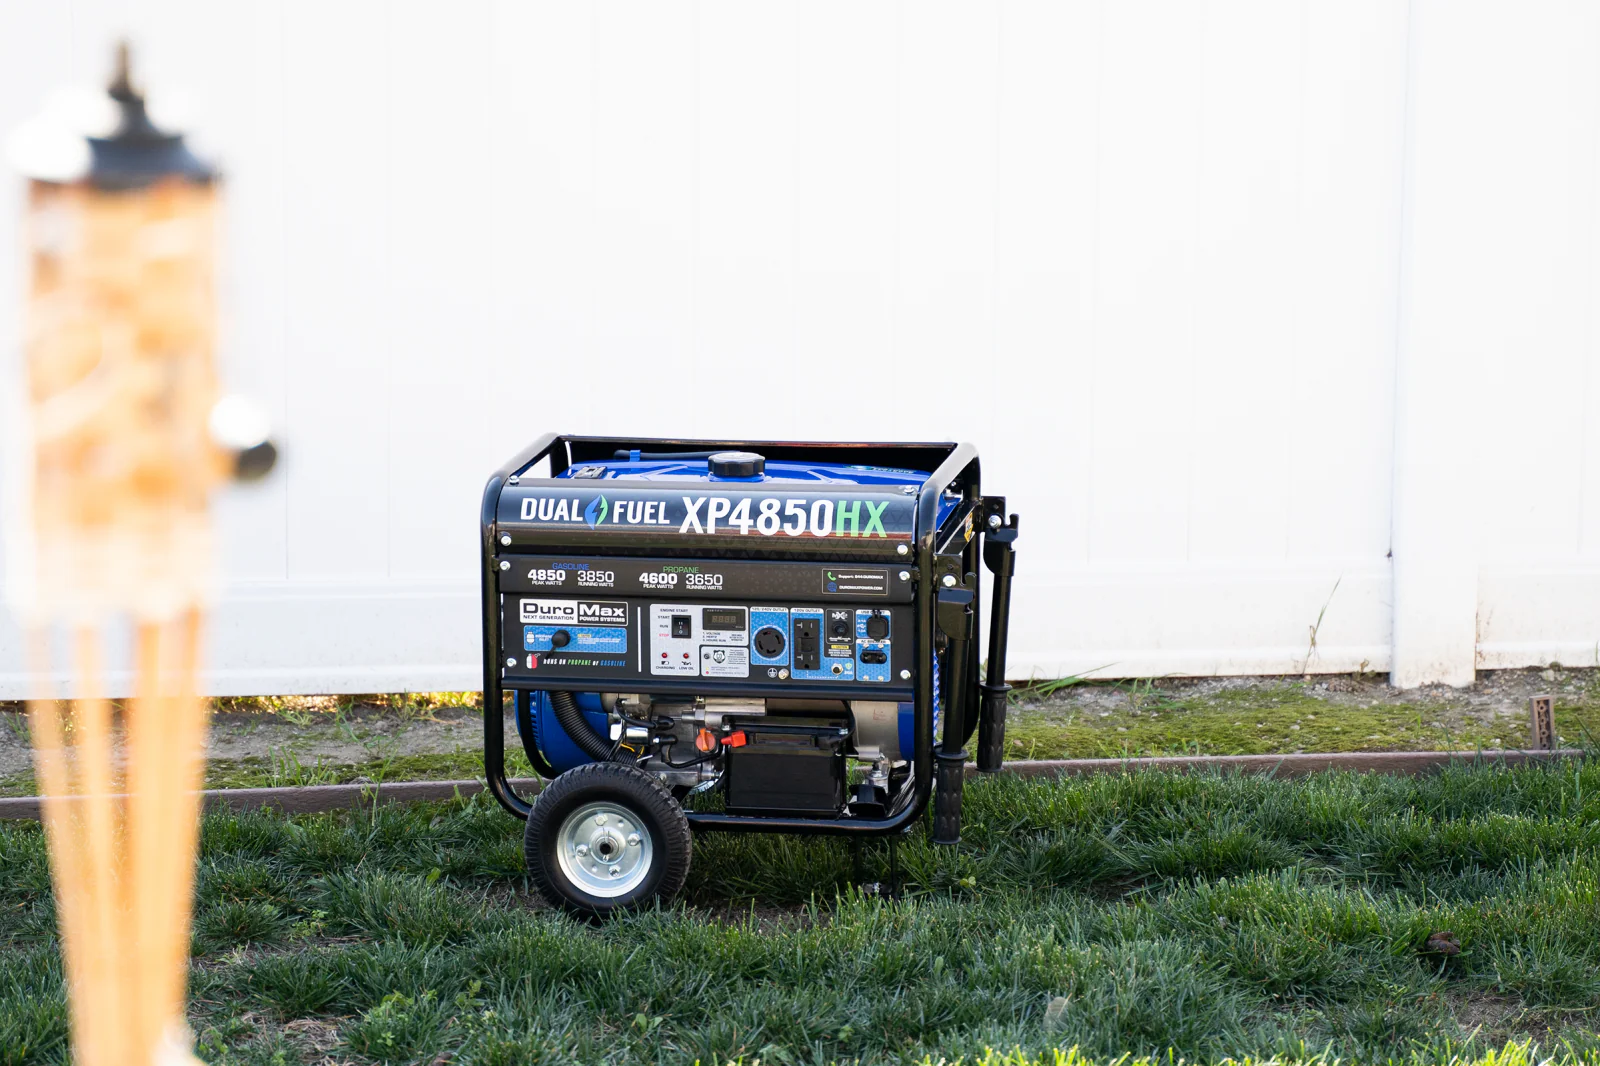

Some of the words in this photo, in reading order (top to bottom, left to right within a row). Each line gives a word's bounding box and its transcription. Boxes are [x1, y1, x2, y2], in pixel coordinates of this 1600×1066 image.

[520, 497, 584, 521] DUAL
[612, 500, 671, 525] FUEL
[678, 496, 890, 538] XP4850HX
[552, 562, 590, 571] GASOLINE
[663, 566, 699, 574] PROPANE
[527, 569, 566, 581] 4850
[577, 570, 615, 583] 3850
[639, 572, 678, 585] 4600
[685, 574, 723, 586] 3650
[523, 602, 574, 615] Duro
[579, 603, 625, 617] Max
